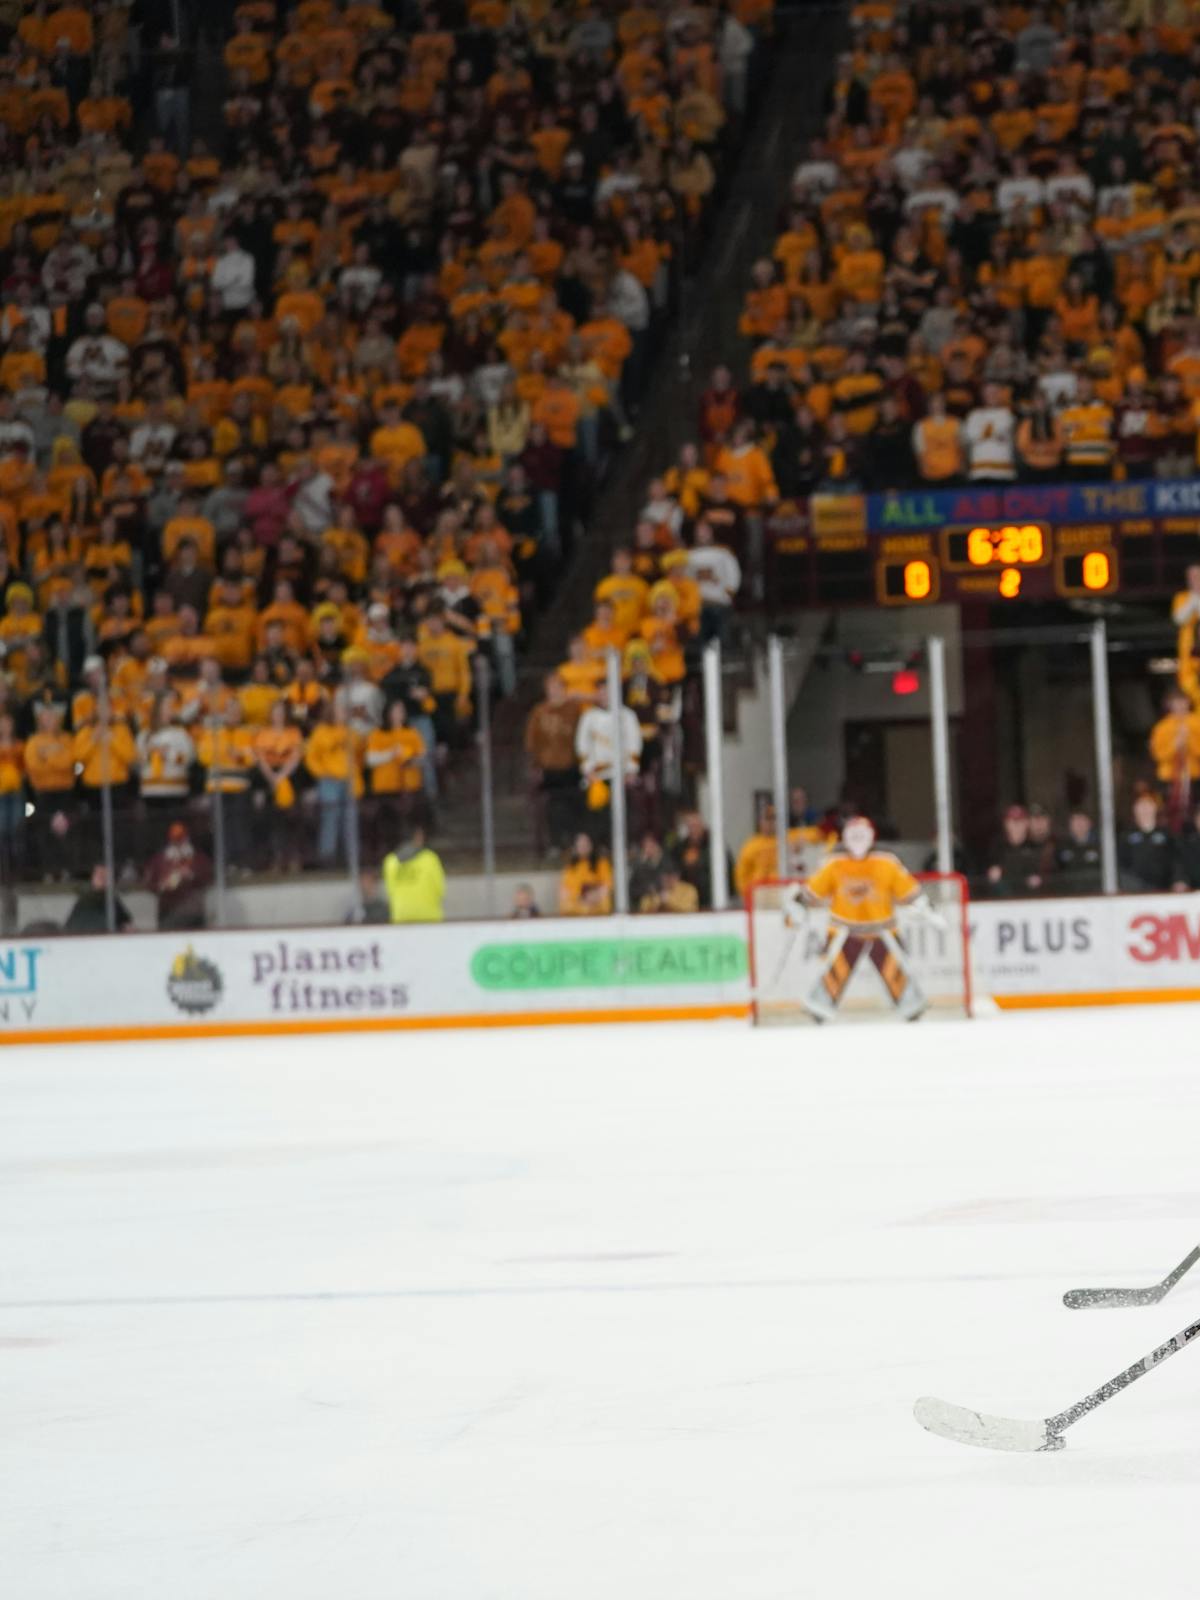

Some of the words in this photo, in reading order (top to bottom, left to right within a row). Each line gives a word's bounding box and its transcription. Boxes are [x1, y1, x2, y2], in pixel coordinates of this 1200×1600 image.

[880, 495, 945, 526] ALL
[952, 487, 1071, 520] ABOUT
[1082, 484, 1147, 515] THE
[967, 524, 1044, 566] 6:20
[904, 560, 931, 599] 0
[1082, 552, 1109, 590] 0
[999, 917, 1092, 955] PLUS
[252, 942, 383, 982] planet
[483, 951, 599, 982] COUPE
[612, 945, 738, 979] HEALTH
[271, 981, 409, 1012] fitness
